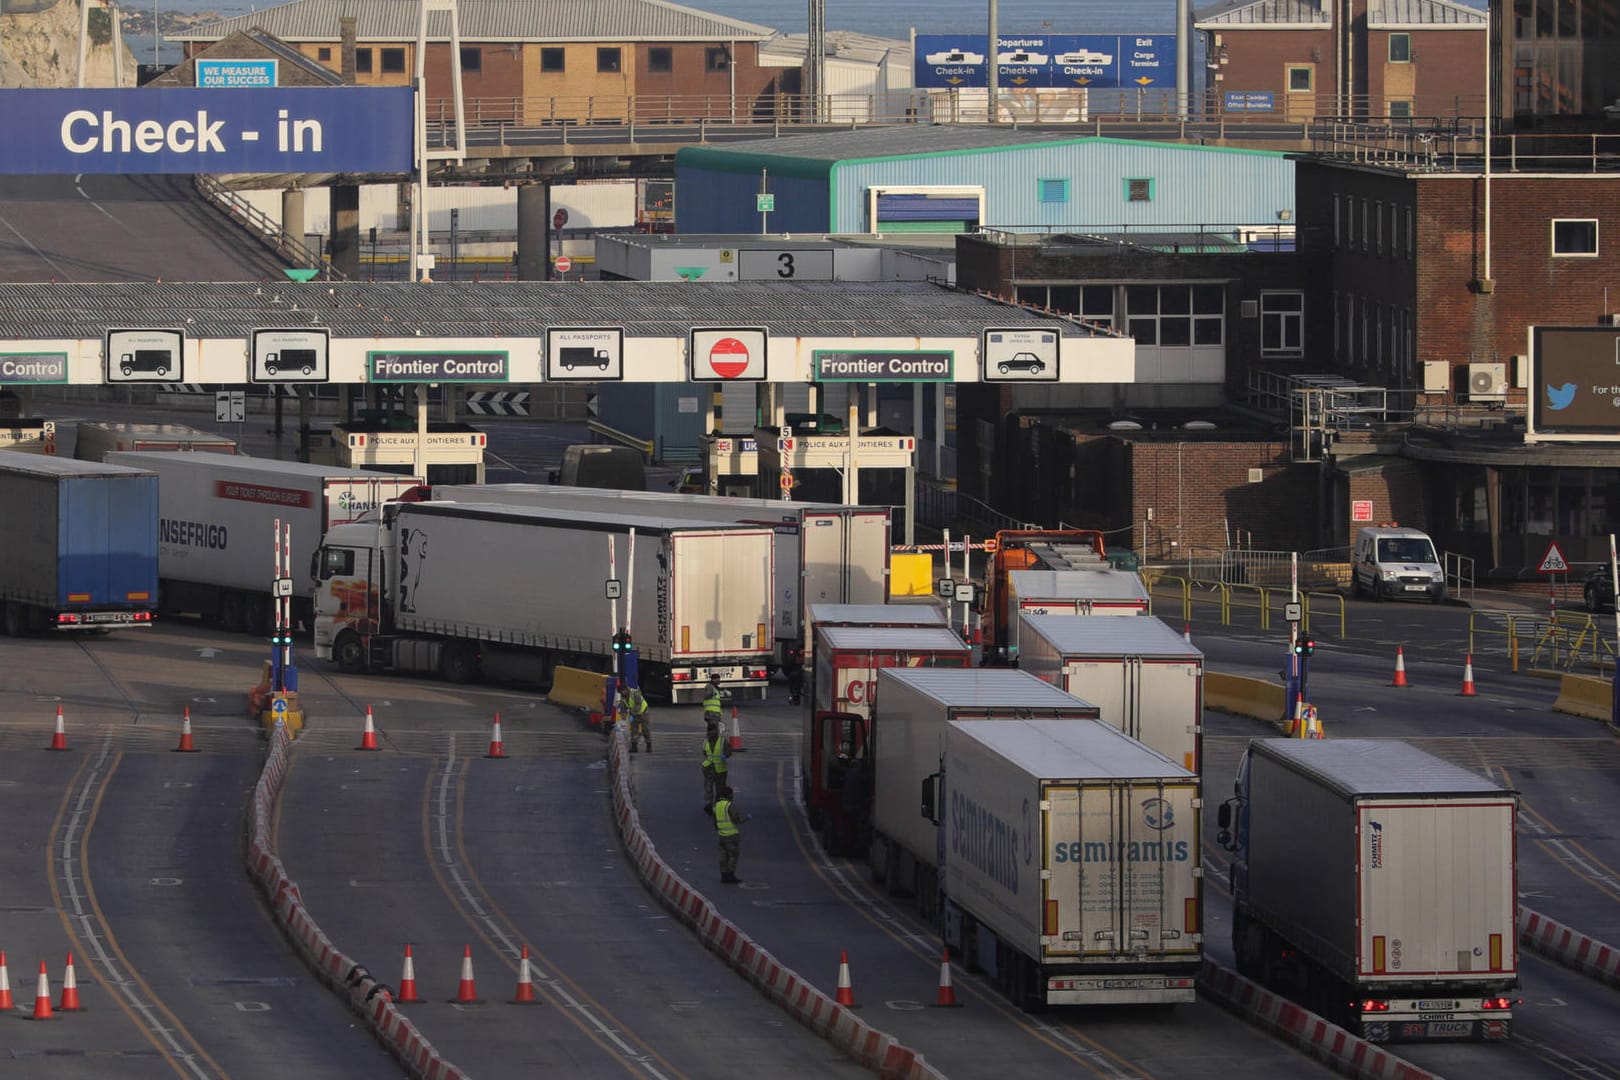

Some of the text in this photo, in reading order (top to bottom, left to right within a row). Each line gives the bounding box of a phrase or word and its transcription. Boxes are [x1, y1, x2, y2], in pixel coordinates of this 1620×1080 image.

[997, 39, 1044, 48] Departures
[1136, 38, 1153, 47] Exit
[1134, 51, 1155, 60] Cargo
[1130, 60, 1159, 68] Terminal
[203, 66, 266, 76] WE MEASURE
[935, 66, 975, 76] Check-in
[999, 66, 1038, 75] Check-in
[1064, 66, 1103, 76] Check-in
[203, 75, 270, 85] OUR SUCCESS
[61, 110, 226, 154] Check
[278, 109, 322, 152] in
[777, 252, 795, 279] 3
[2, 361, 63, 376] Control
[375, 359, 503, 374] Frontier Control
[821, 358, 949, 373] Frontier Control
[1592, 385, 1608, 395] For
[45, 422, 53, 432] 2
[782, 427, 790, 437] 5
[369, 437, 398, 445] POLICE
[399, 437, 415, 445] AUX
[743, 441, 758, 451] UK
[798, 440, 826, 448] POLICE
[828, 440, 843, 448] AUX
[401, 528, 410, 613] MAN
[1054, 840, 1188, 864] semiramis
